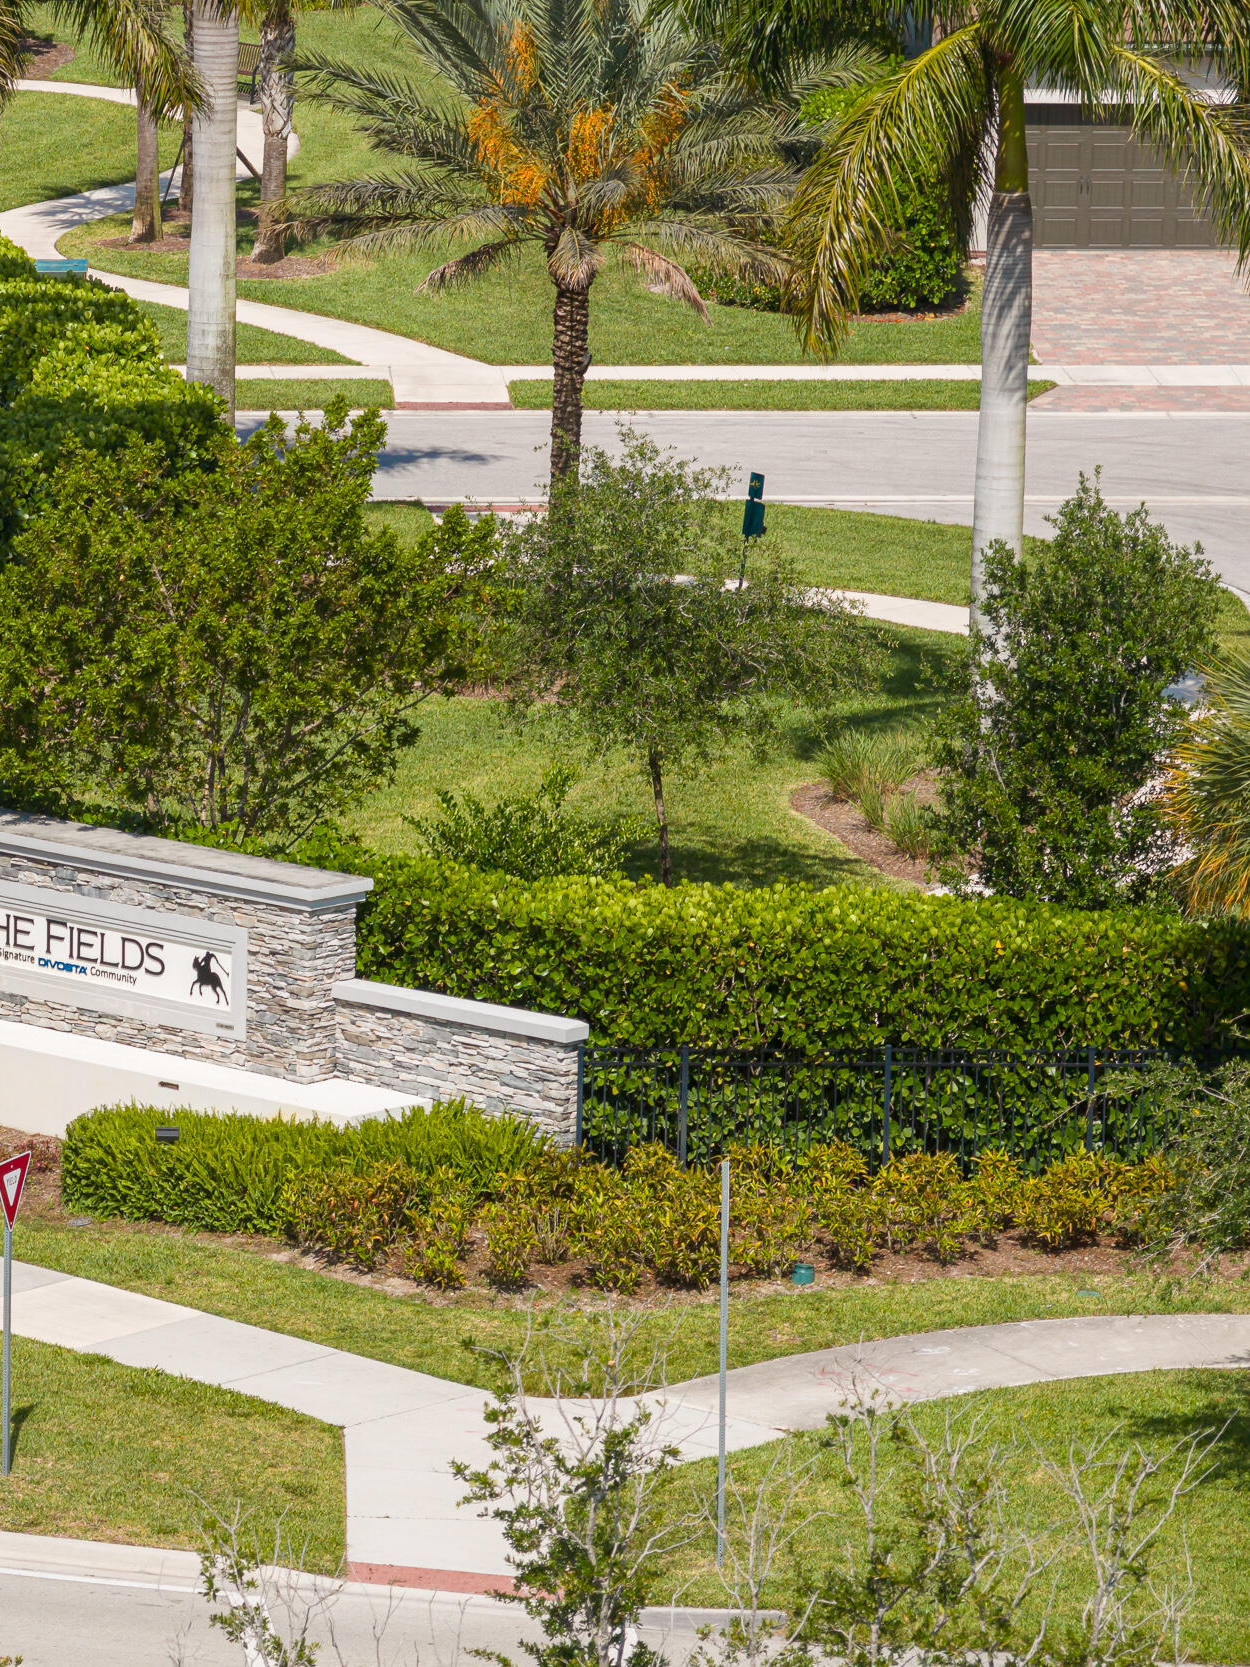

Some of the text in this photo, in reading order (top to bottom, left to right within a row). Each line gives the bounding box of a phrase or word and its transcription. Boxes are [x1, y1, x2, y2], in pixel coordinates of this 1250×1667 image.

[45, 918, 166, 976] FIELDS
[38, 957, 88, 975] DIVOSTA
[90, 966, 137, 986] Community
